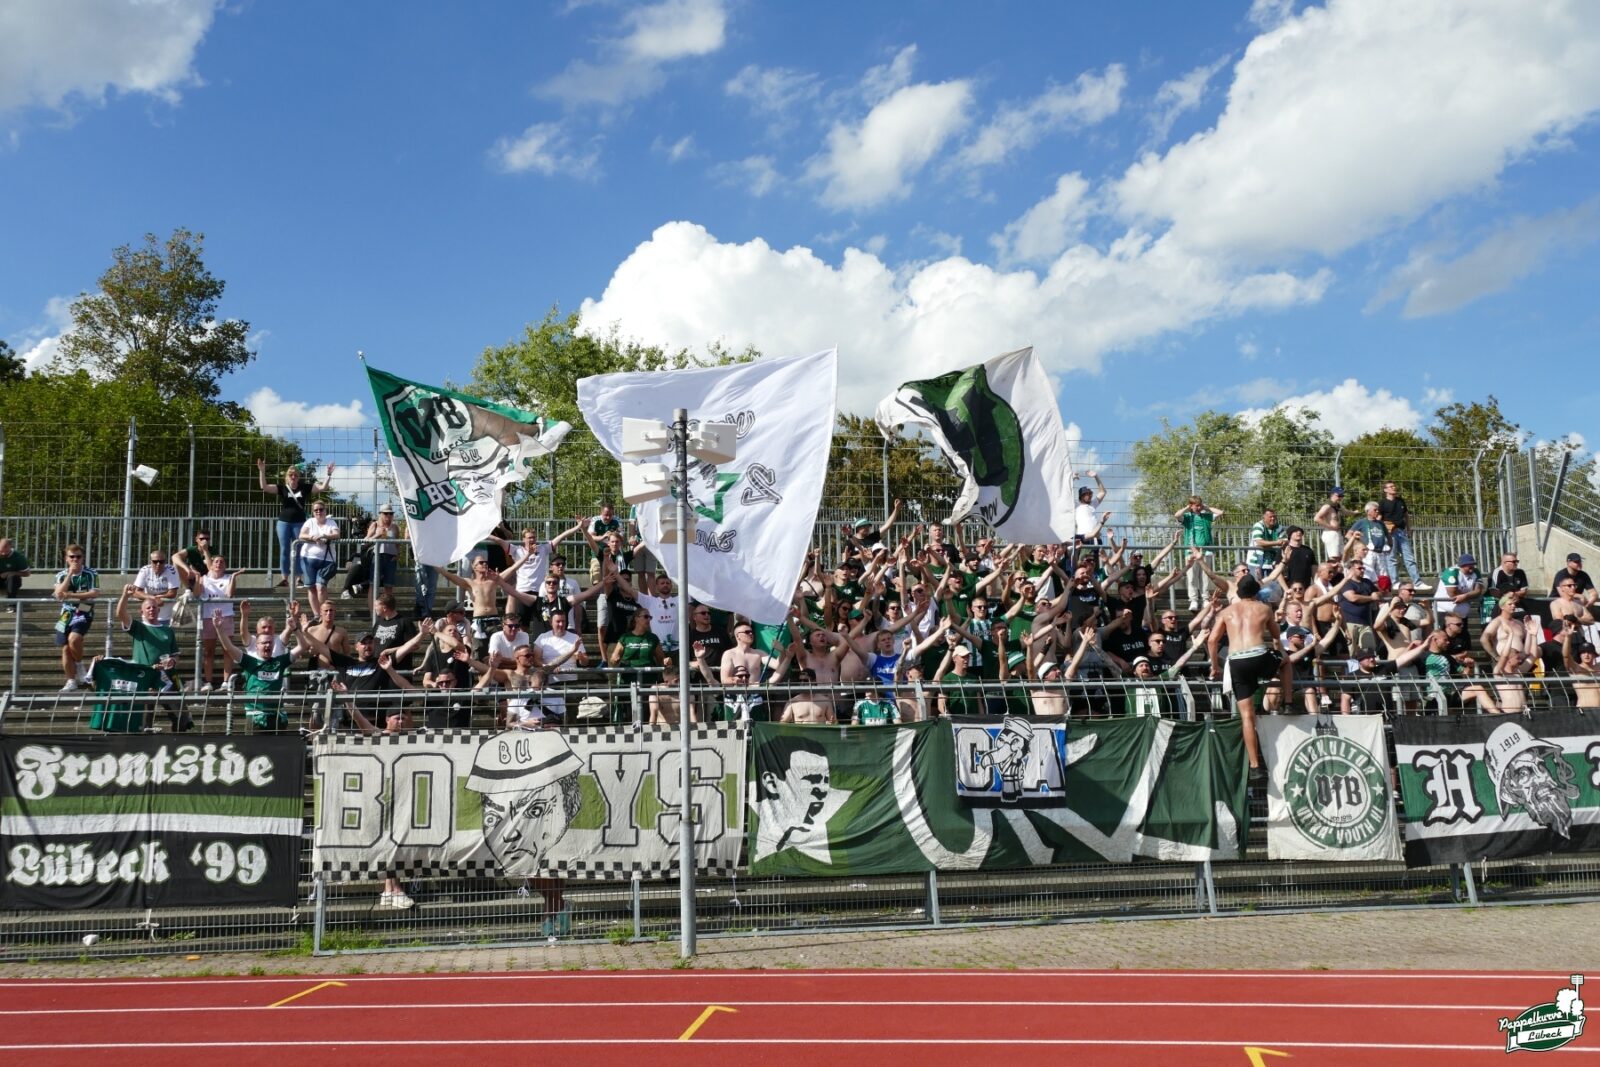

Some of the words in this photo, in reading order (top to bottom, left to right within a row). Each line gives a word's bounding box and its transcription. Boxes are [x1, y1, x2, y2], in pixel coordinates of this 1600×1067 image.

[498, 737, 533, 765] BU
[1499, 732, 1521, 753] 1919
[1294, 739, 1376, 776] SUBKULTUR
[1336, 818, 1376, 844] YOUTH
[7, 840, 171, 887] Lübeck
